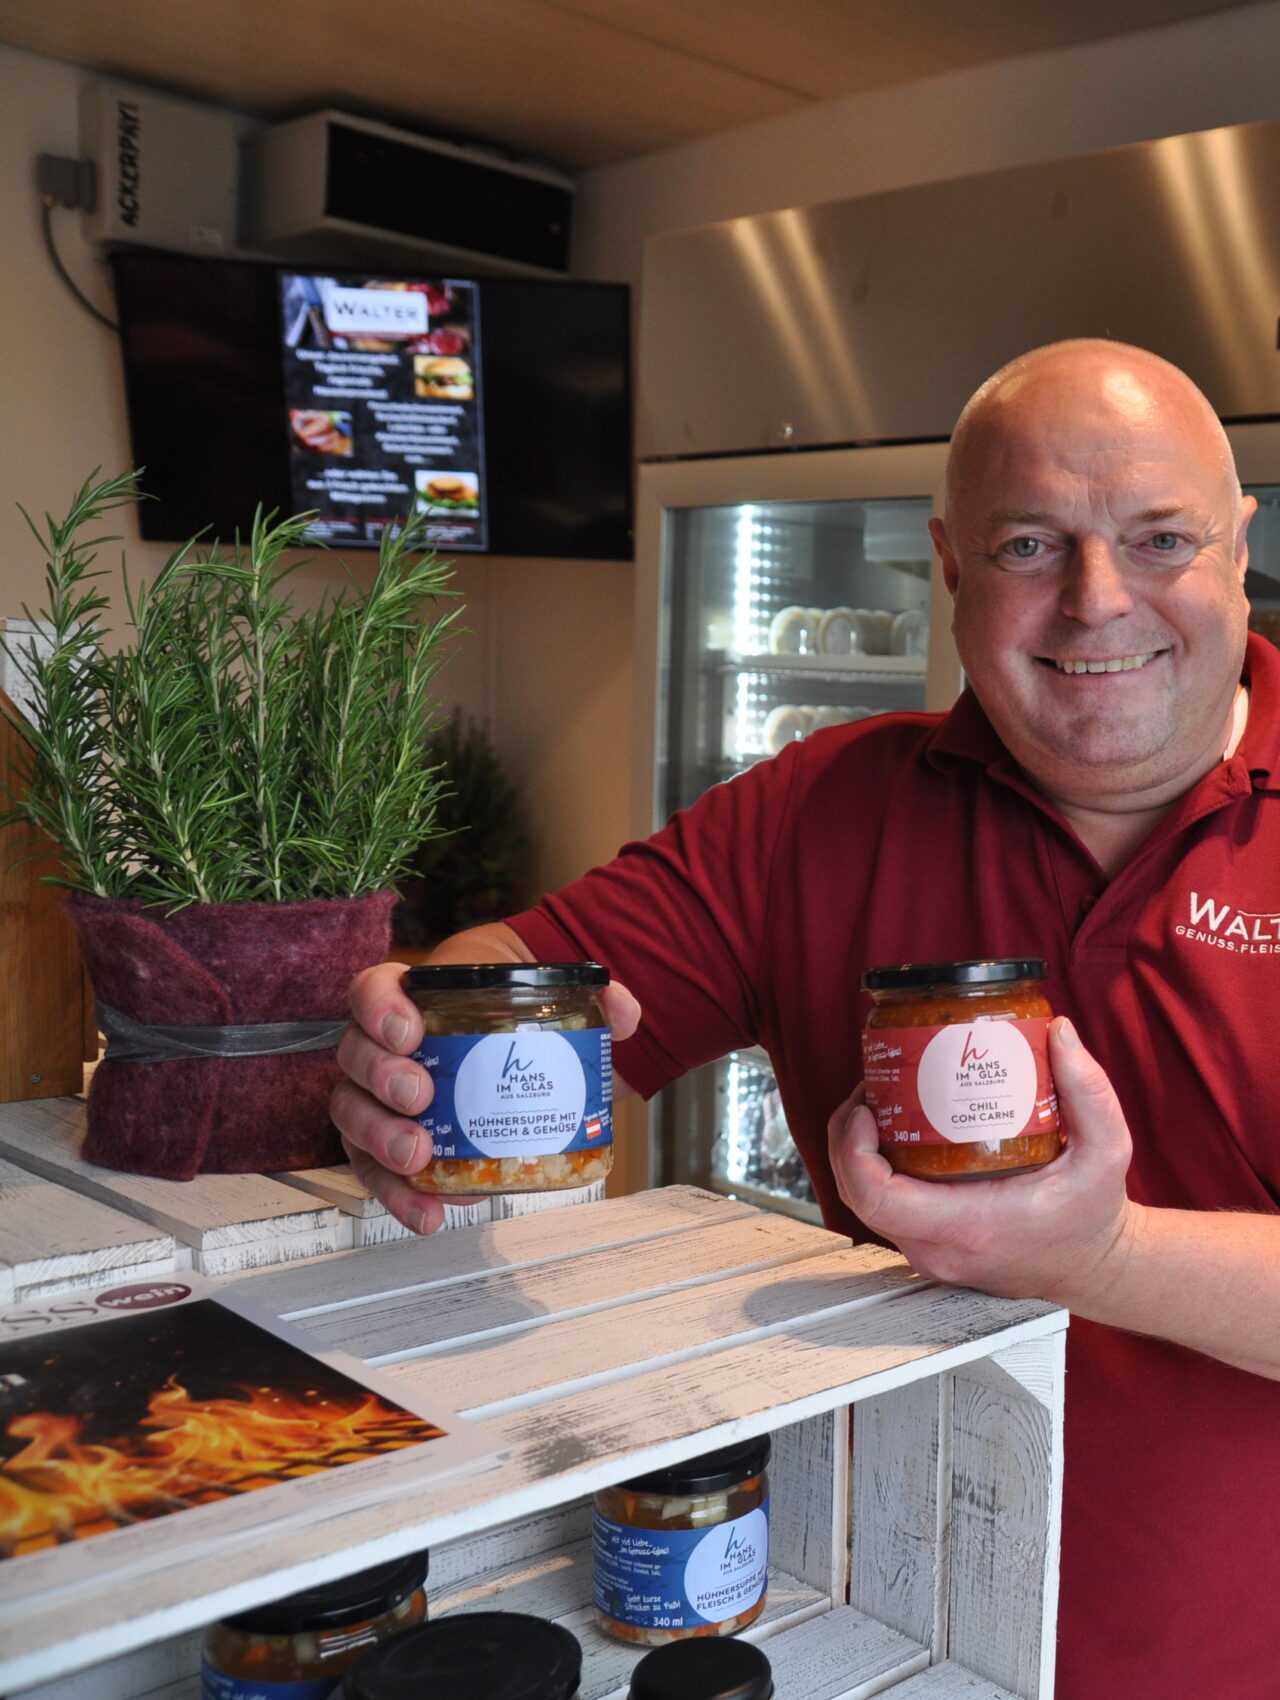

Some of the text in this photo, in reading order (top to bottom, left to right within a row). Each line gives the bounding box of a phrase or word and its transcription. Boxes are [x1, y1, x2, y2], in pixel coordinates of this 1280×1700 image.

[119, 101, 140, 226] ACKERPAY!
[334, 302, 419, 320] WALTER
[967, 1061, 1000, 1072] HANS
[509, 1072, 546, 1084] HANS
[955, 1068, 1008, 1081] IM GLAS
[496, 1081, 554, 1093] IM GLAS
[974, 1079, 1006, 1087] SALZBURG
[516, 1091, 551, 1099] SALZBURG
[969, 1101, 998, 1112] CHILI
[468, 1113, 557, 1128] HÜHNERSUPPE
[559, 1112, 577, 1122] MIT
[951, 1110, 1016, 1124] CON CARNE
[469, 1122, 577, 1139] FLEISCH & GEMÜSE
[894, 1130, 920, 1142] 340 ml
[433, 1145, 455, 1156] 40 ml
[101, 1285, 187, 1308] wein
[729, 1544, 753, 1561] HANS
[720, 1549, 756, 1571] IM GLAS
[696, 1574, 756, 1602] HÜHNERSUPPE
[696, 1595, 735, 1611] FLEISCH
[736, 1592, 742, 1600] &
[653, 1616, 684, 1627] 340 ml
